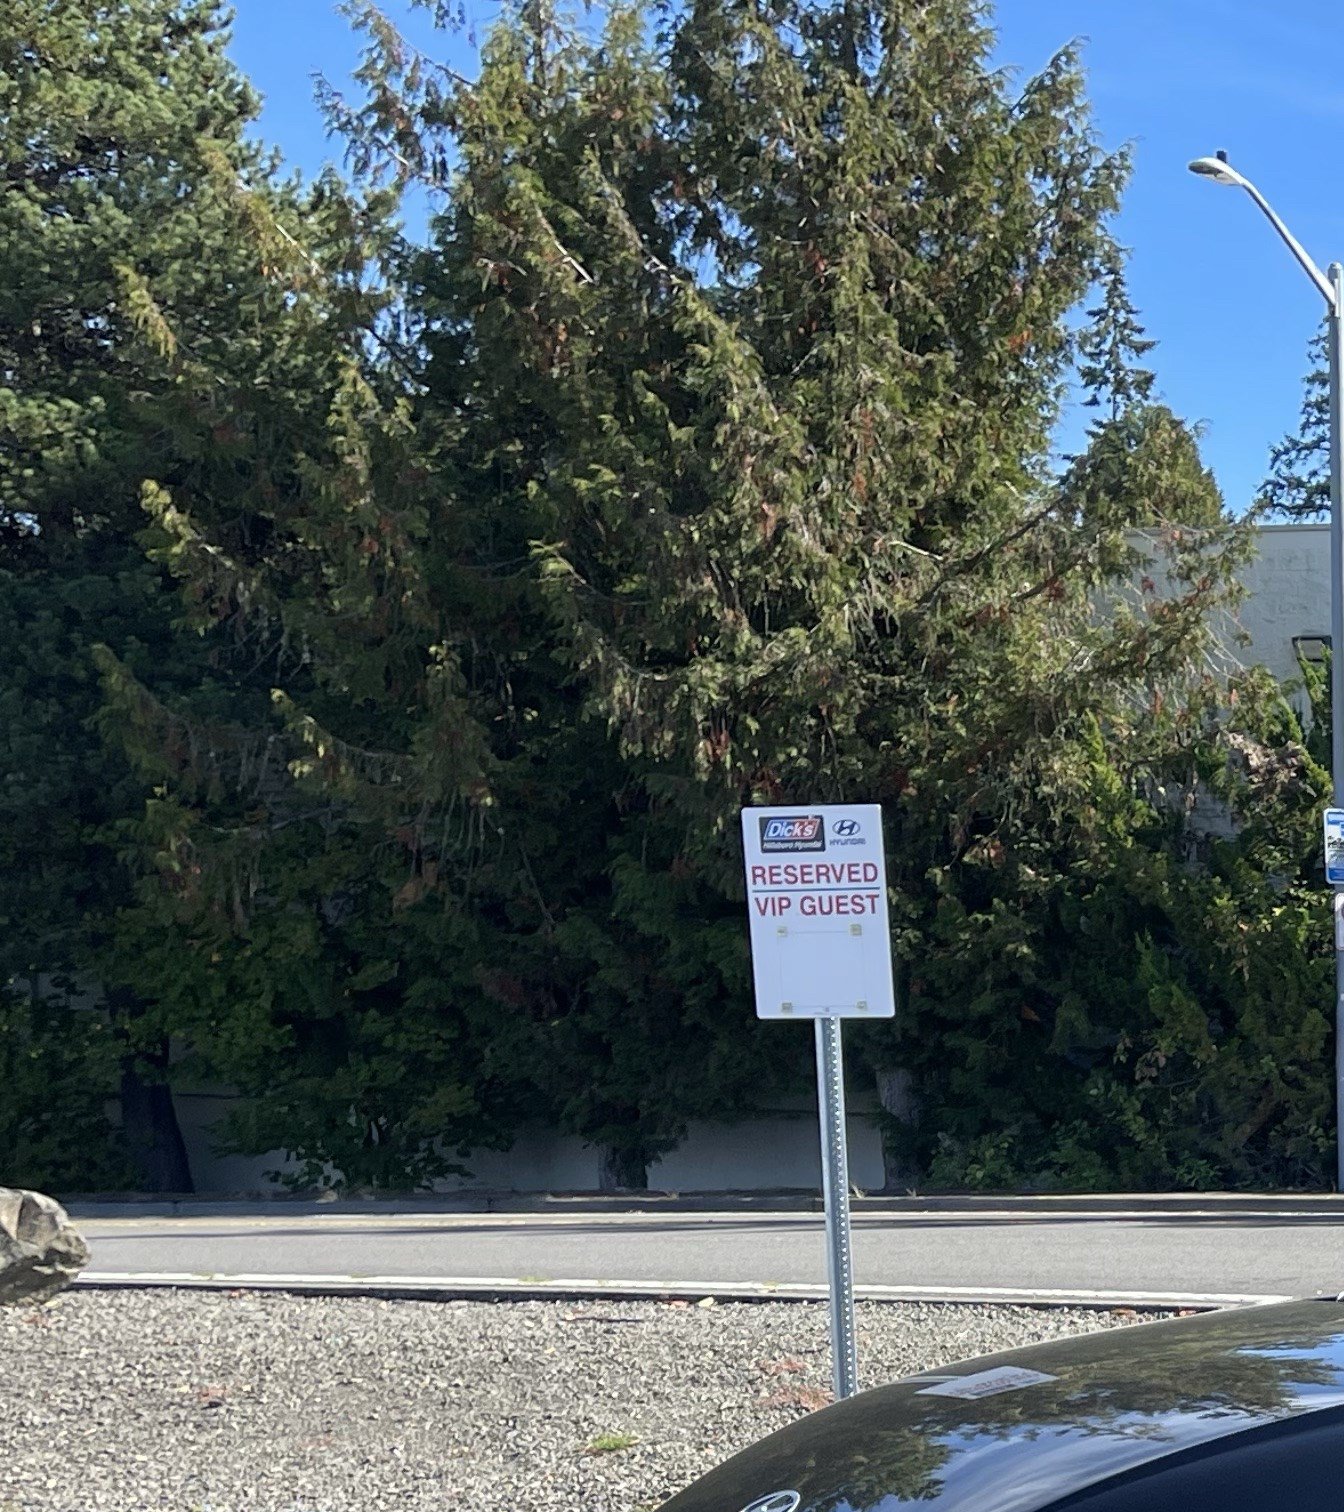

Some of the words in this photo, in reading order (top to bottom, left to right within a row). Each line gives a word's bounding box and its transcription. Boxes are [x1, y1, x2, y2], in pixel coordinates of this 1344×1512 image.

[768, 820, 815, 837] Dick's
[752, 863, 878, 885] RESERVED
[755, 896, 791, 917] VIP
[799, 894, 880, 916] GUEST
